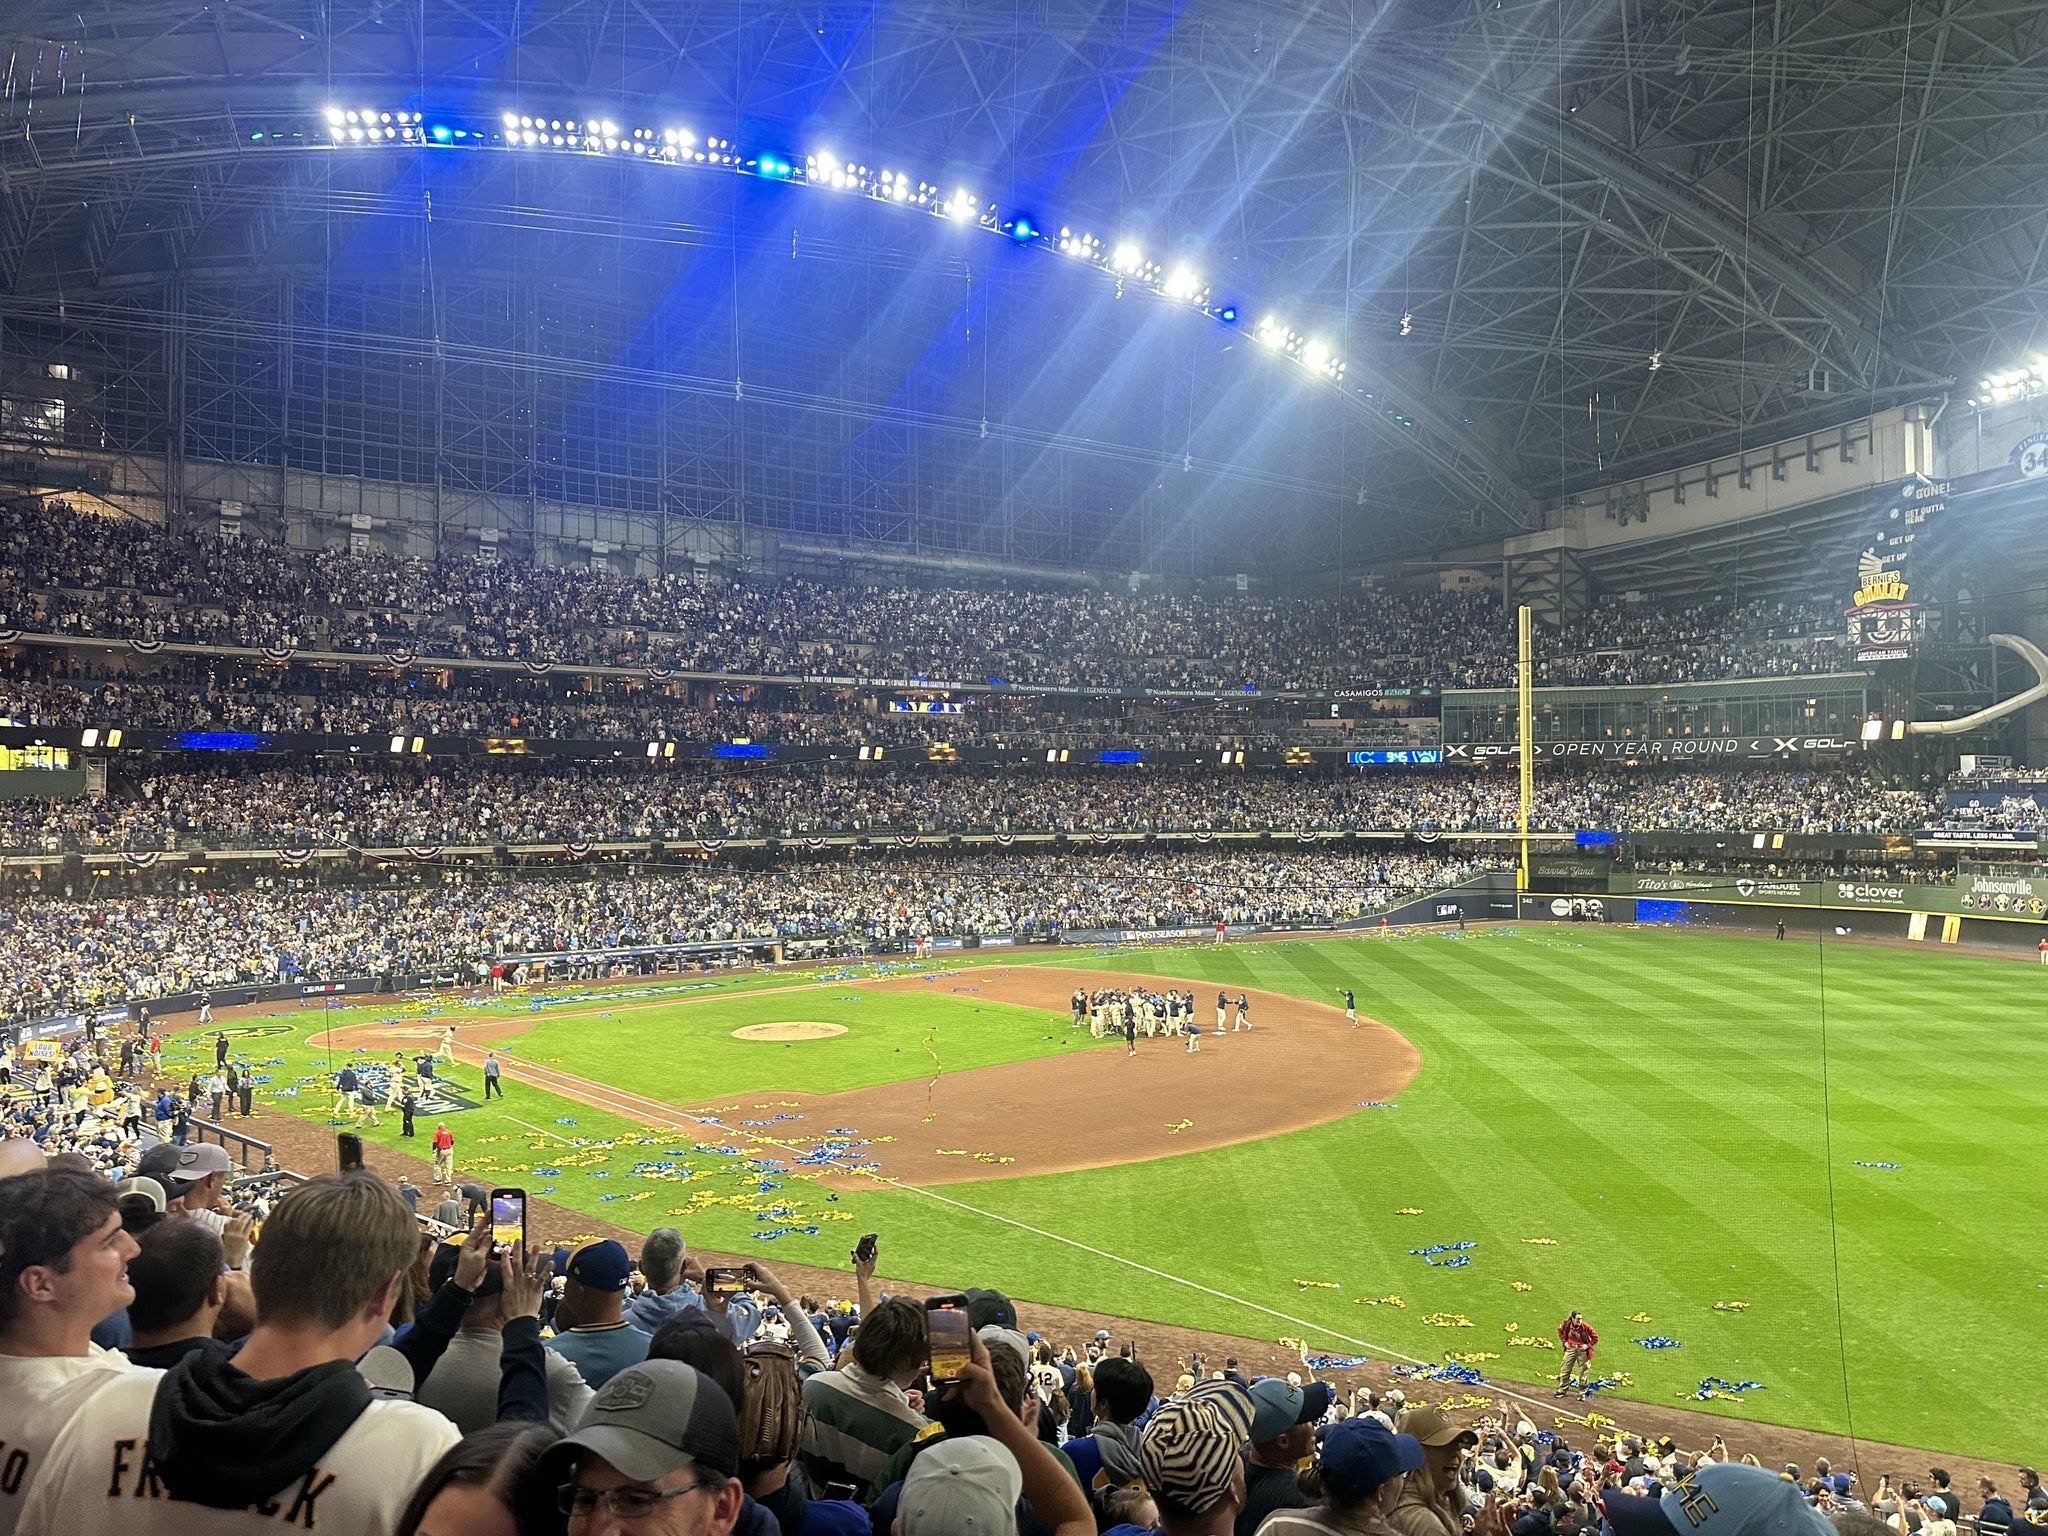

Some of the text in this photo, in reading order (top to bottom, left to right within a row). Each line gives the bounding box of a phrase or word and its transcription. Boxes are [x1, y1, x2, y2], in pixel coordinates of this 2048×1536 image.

[2023, 447, 2048, 472] 34
[1915, 483, 1951, 500] GONE!
[1889, 533, 1916, 546] GET UP
[1896, 552, 1907, 562] UP
[1862, 571, 1901, 588] BERNIE'S
[1853, 583, 1910, 607] CHALET
[1018, 684, 1058, 693] Northwestern
[1084, 687, 1107, 695] LEGENDS
[1153, 689, 1194, 697] Northwestern
[1334, 689, 1384, 698] CASAMIGOS
[1552, 739, 1739, 757] OPEN YEAR ROUND
[1537, 866, 1596, 877] Barrel Yard
[1637, 878, 1669, 890] Tito's
[1757, 881, 1801, 892] FANDUEL
[1970, 877, 2033, 896] Johnsonville
[1855, 884, 1904, 899] clover
[1136, 929, 1187, 940] POSTSEASON
[34, 1043, 53, 1051] LOUD
[28, 1049, 56, 1058] NOISES!
